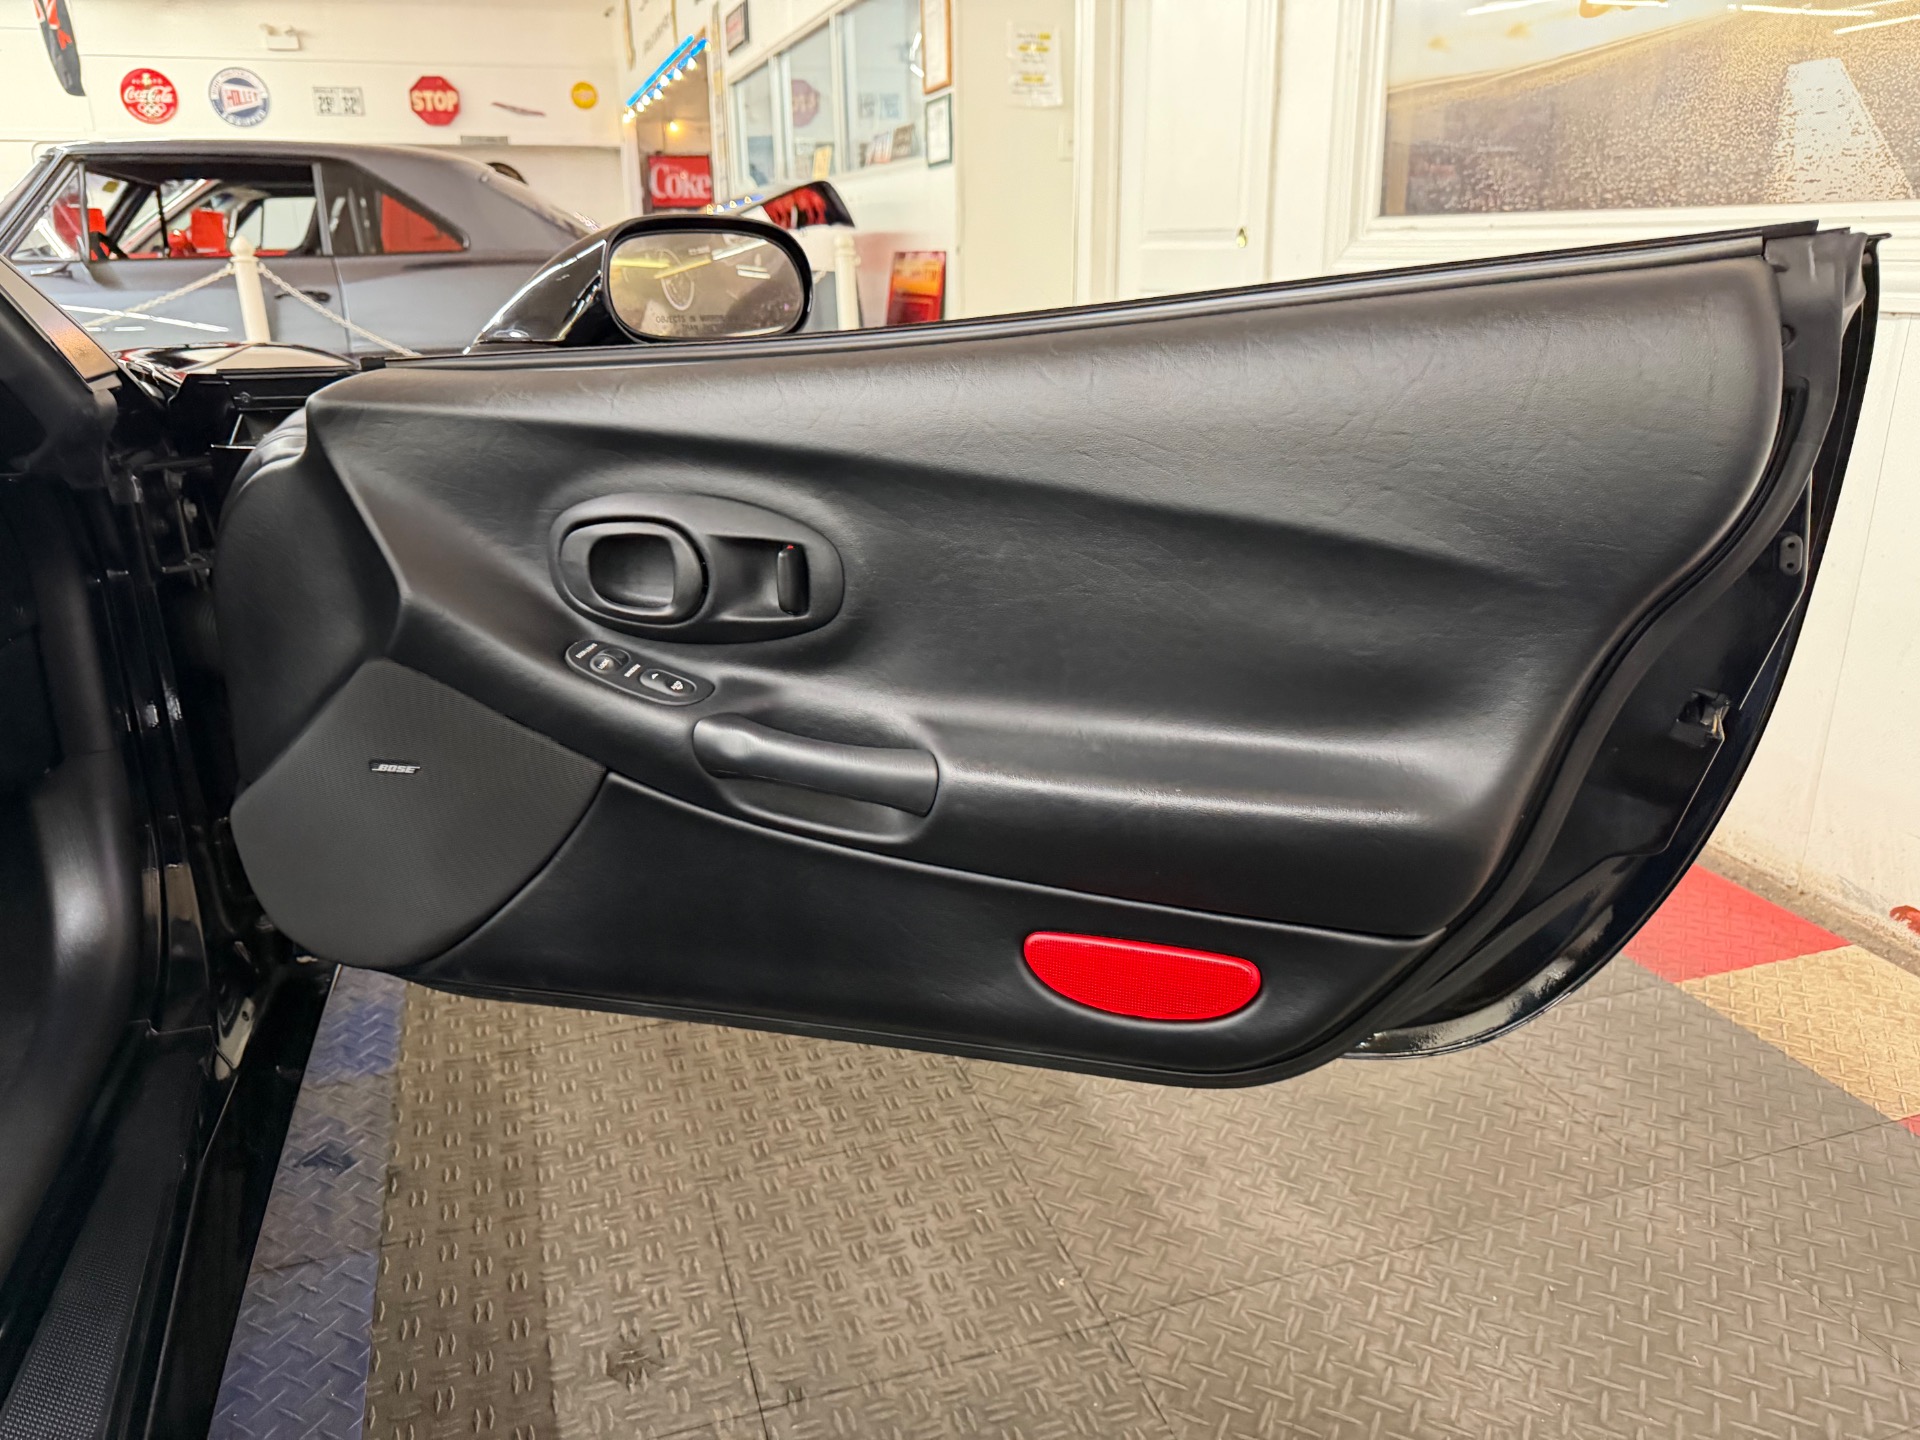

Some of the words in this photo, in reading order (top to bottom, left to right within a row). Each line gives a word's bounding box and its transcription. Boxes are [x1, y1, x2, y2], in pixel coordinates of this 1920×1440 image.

[411, 90, 458, 111] STOP
[649, 163, 711, 199] Coke
[372, 764, 420, 774] BOSE
